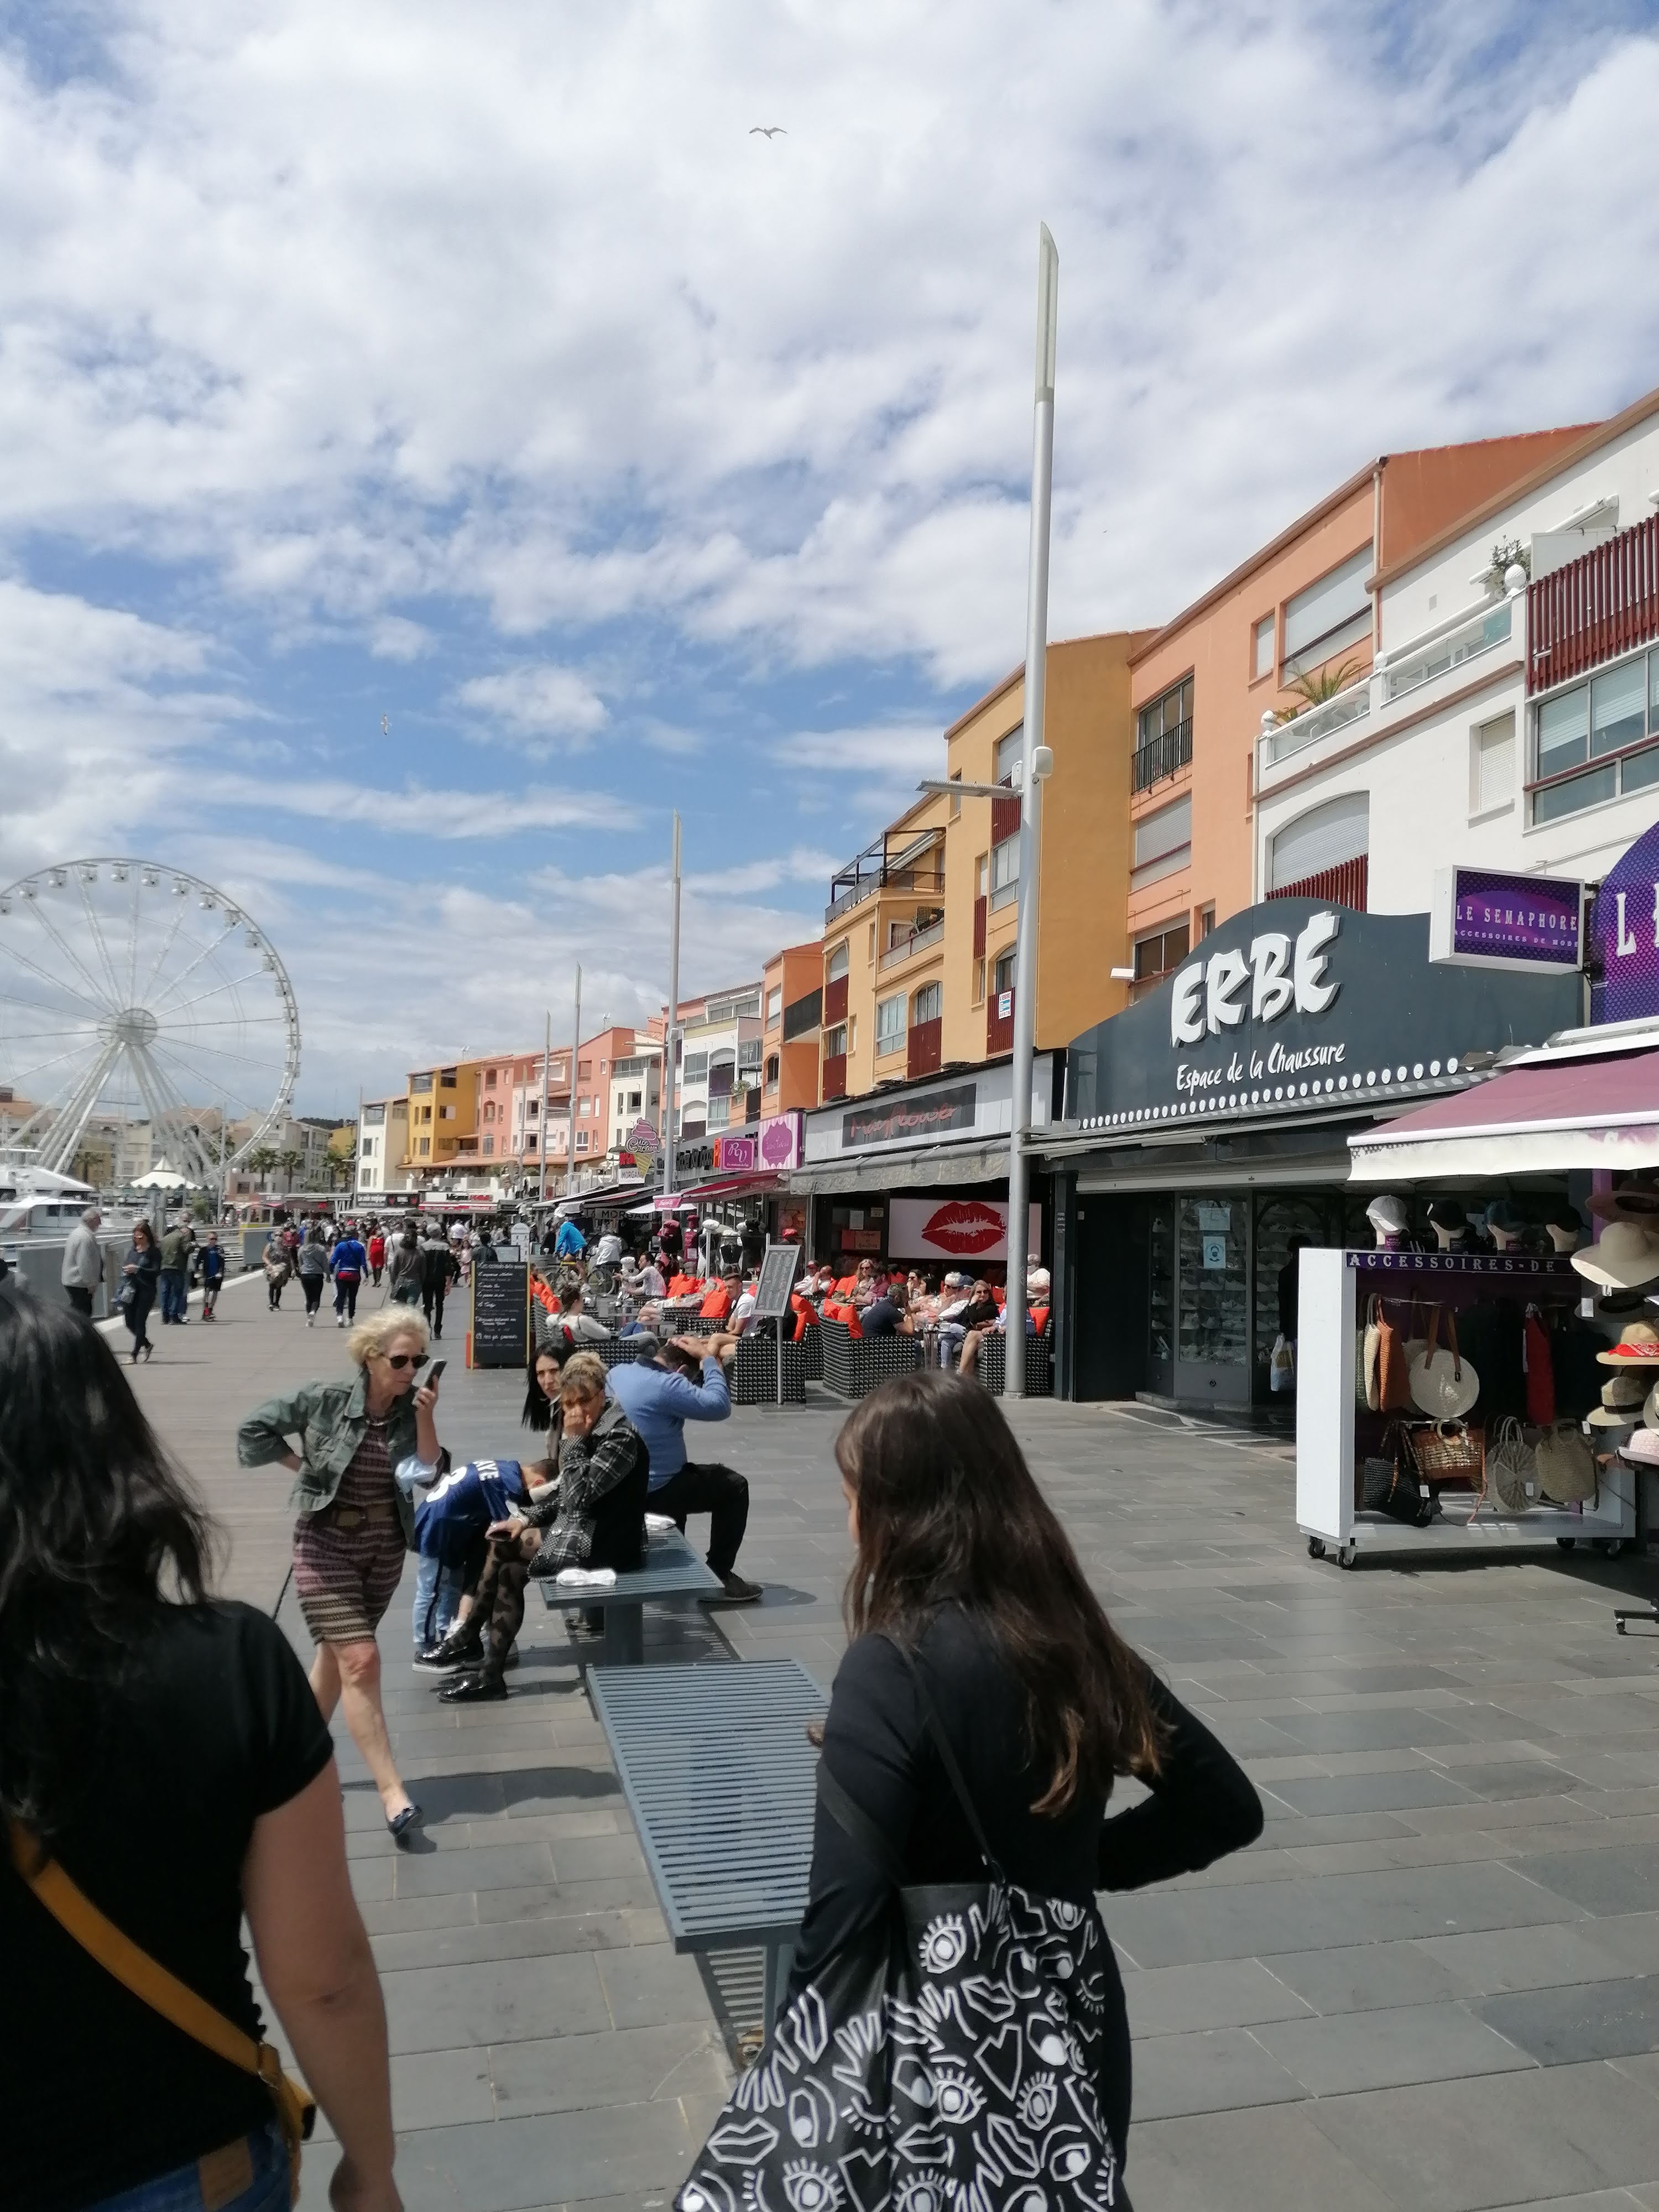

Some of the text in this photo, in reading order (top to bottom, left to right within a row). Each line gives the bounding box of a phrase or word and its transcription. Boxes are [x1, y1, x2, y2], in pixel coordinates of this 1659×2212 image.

[1456, 905, 1577, 931] LE SEMAPHORE
[1176, 1042, 1347, 1097] Espace de la Chaussure
